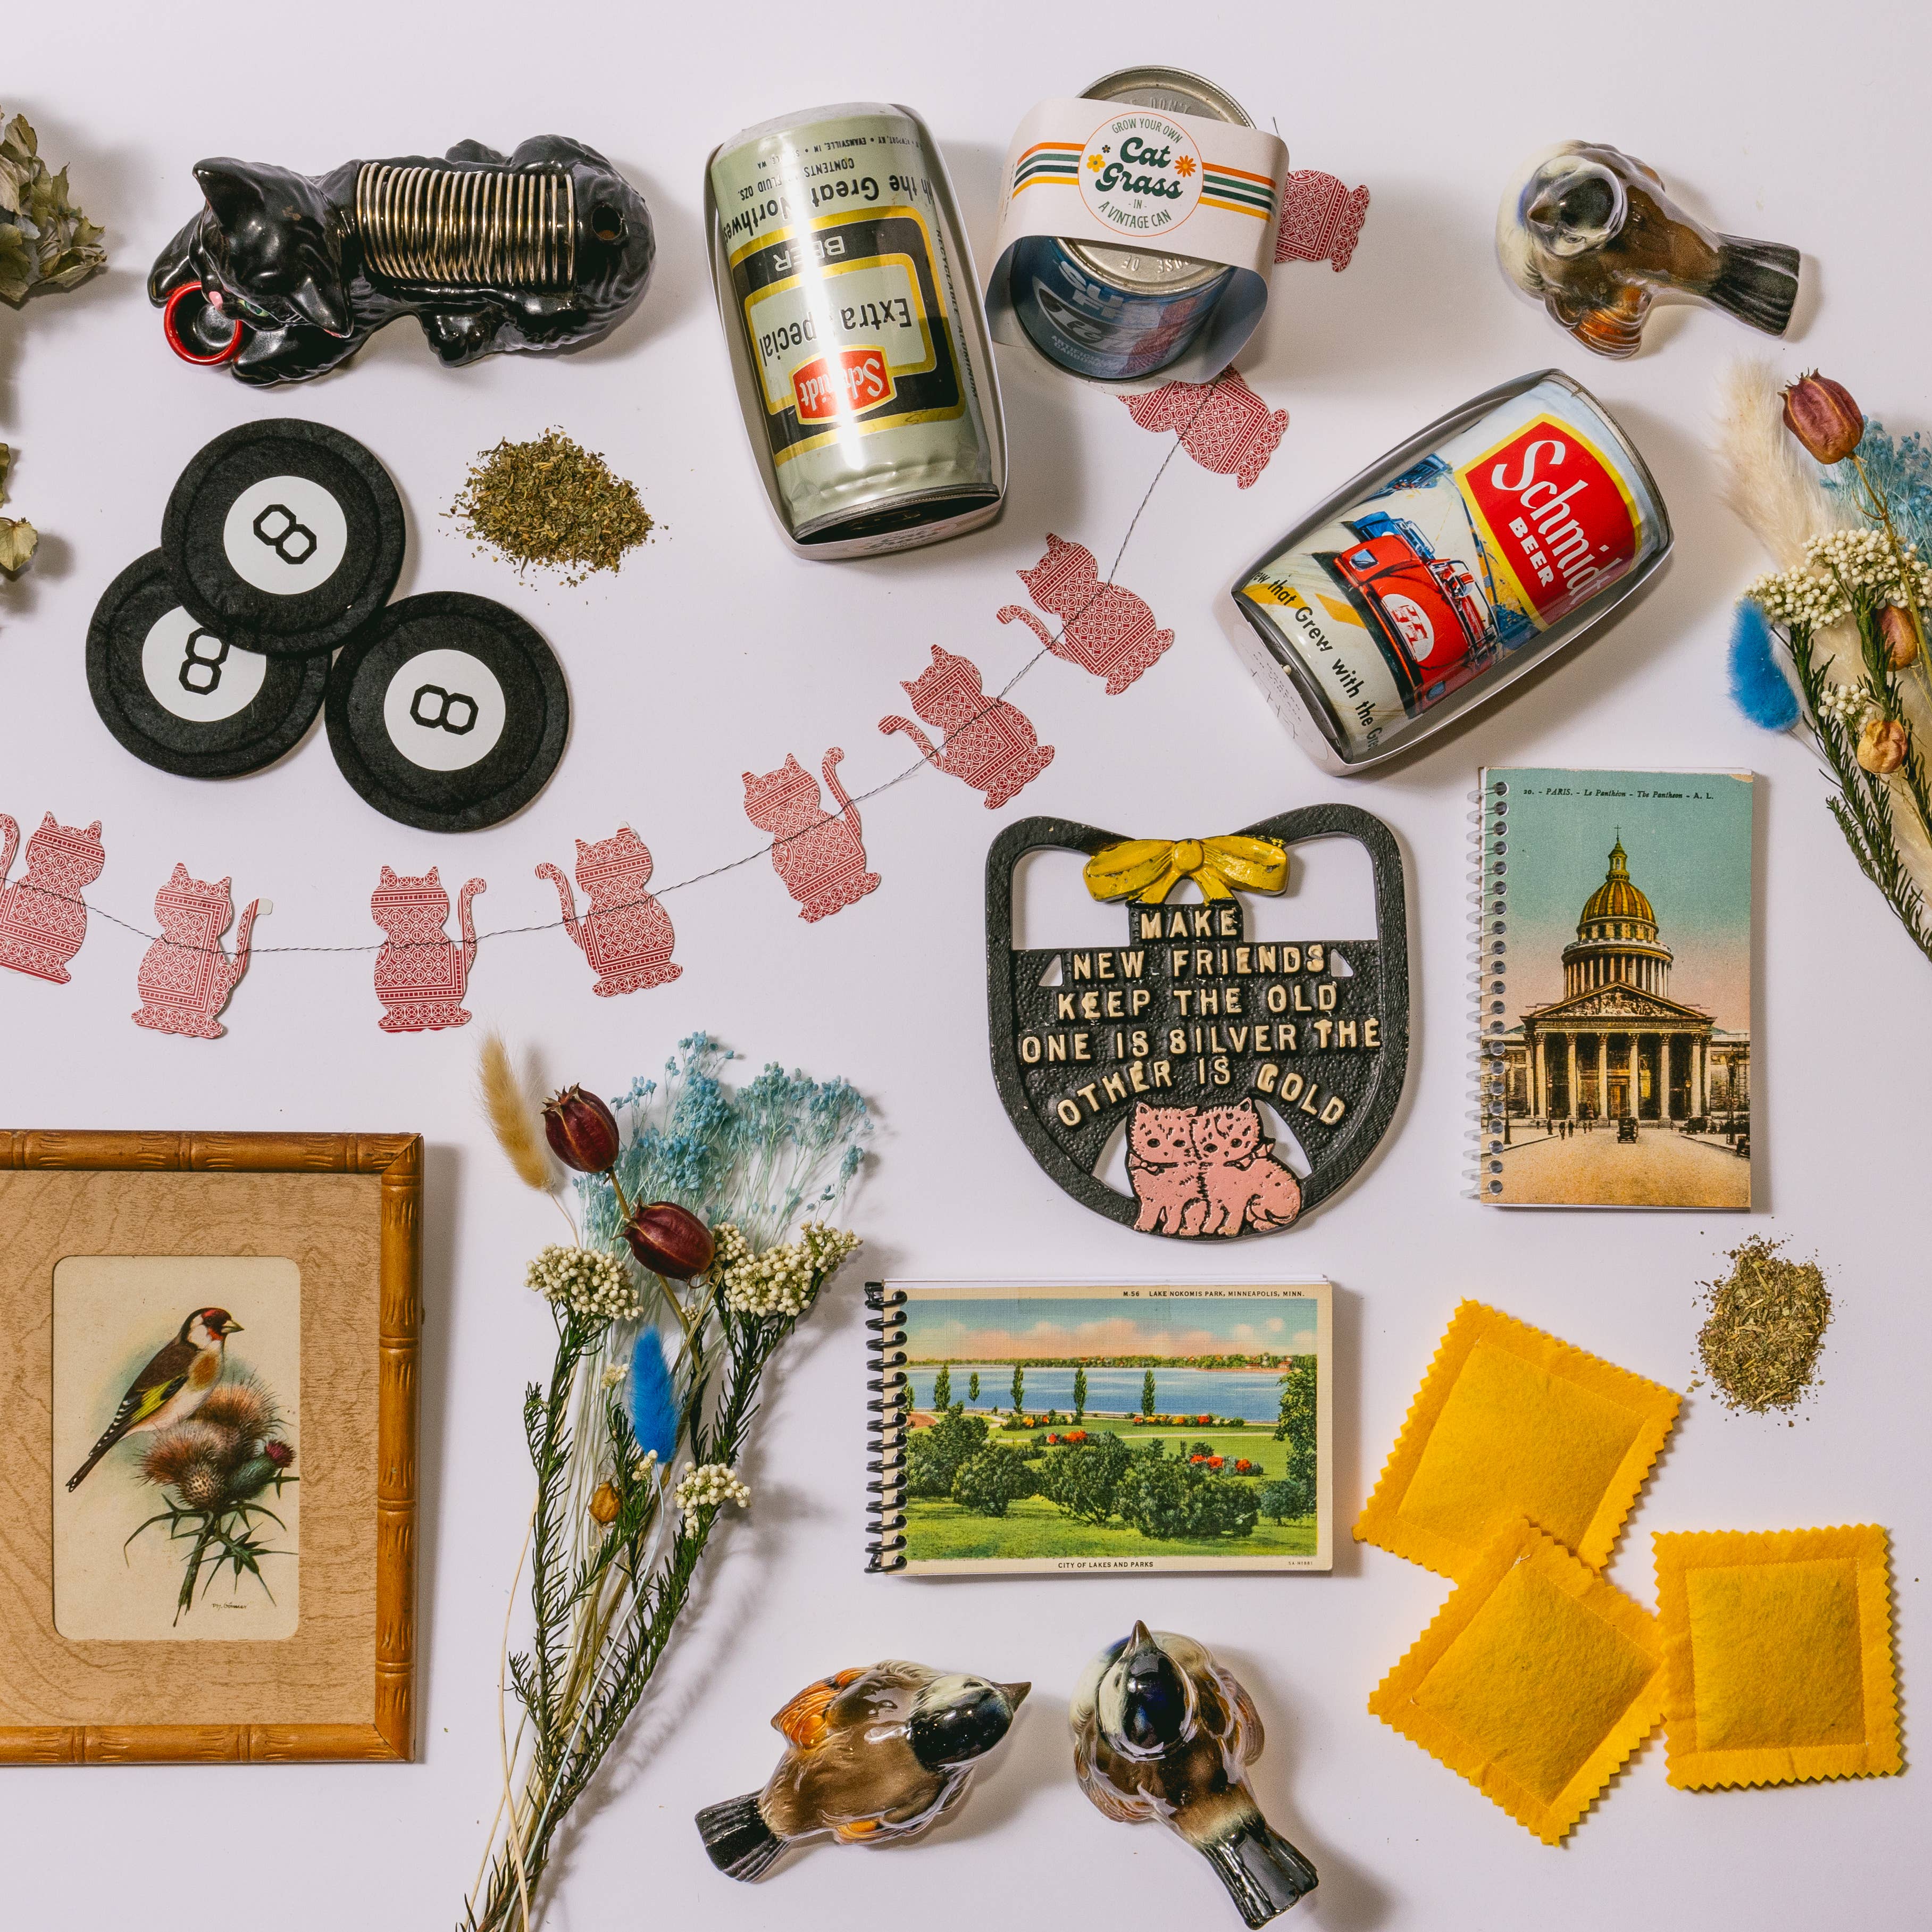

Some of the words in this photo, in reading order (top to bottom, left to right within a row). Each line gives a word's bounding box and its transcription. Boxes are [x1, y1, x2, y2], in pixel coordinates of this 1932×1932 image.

[1112, 118, 1136, 133] GROW
[1140, 118, 1162, 132] YOUR
[1162, 126, 1183, 144] OWN
[757, 161, 767, 170] WA
[804, 157, 854, 178] CONTENTS
[1120, 137, 1171, 168] Cat
[738, 185, 754, 202] OZS.
[758, 171, 782, 194] FLUID
[811, 177, 879, 207] Great
[889, 175, 917, 202] the
[1095, 162, 1183, 199] Grass
[1098, 201, 1110, 212] A
[1108, 206, 1149, 229] VINTAGE
[1151, 210, 1172, 227] CAN
[1134, 199, 1142, 209] IN
[773, 235, 846, 272] BEER
[840, 298, 913, 331] Extra
[936, 229, 959, 315] RECYCLABLE
[957, 323, 978, 398] ALUMINUM
[759, 311, 835, 367] pecial
[253, 503, 318, 565] 8
[1491, 440, 1622, 605] Schmidt
[1508, 516, 1554, 588] BEER
[178, 627, 232, 696] 8
[1267, 579, 1297, 606] that
[1295, 606, 1333, 653] Grew
[1332, 656, 1360, 700] with
[1355, 700, 1376, 727] the
[409, 683, 480, 736] 8
[1546, 788, 1574, 796] PARIS.
[1595, 789, 1626, 798] Panthéon
[1141, 907, 1238, 941] MAKE
[1073, 950, 1145, 981] NEW
[1173, 943, 1325, 978] FRIENDS
[1058, 990, 1151, 1021] KEEP
[1174, 986, 1243, 1017] THE
[1267, 984, 1337, 1013] OLD
[1022, 1032, 1092, 1064] ONE
[1117, 1029, 1149, 1059] IS
[1169, 1024, 1297, 1057] SILVER
[1314, 1018, 1382, 1049] THE
[1057, 1060, 1172, 1128] OTHER
[1198, 1056, 1231, 1086] IS
[1256, 1063, 1345, 1126] GOLD
